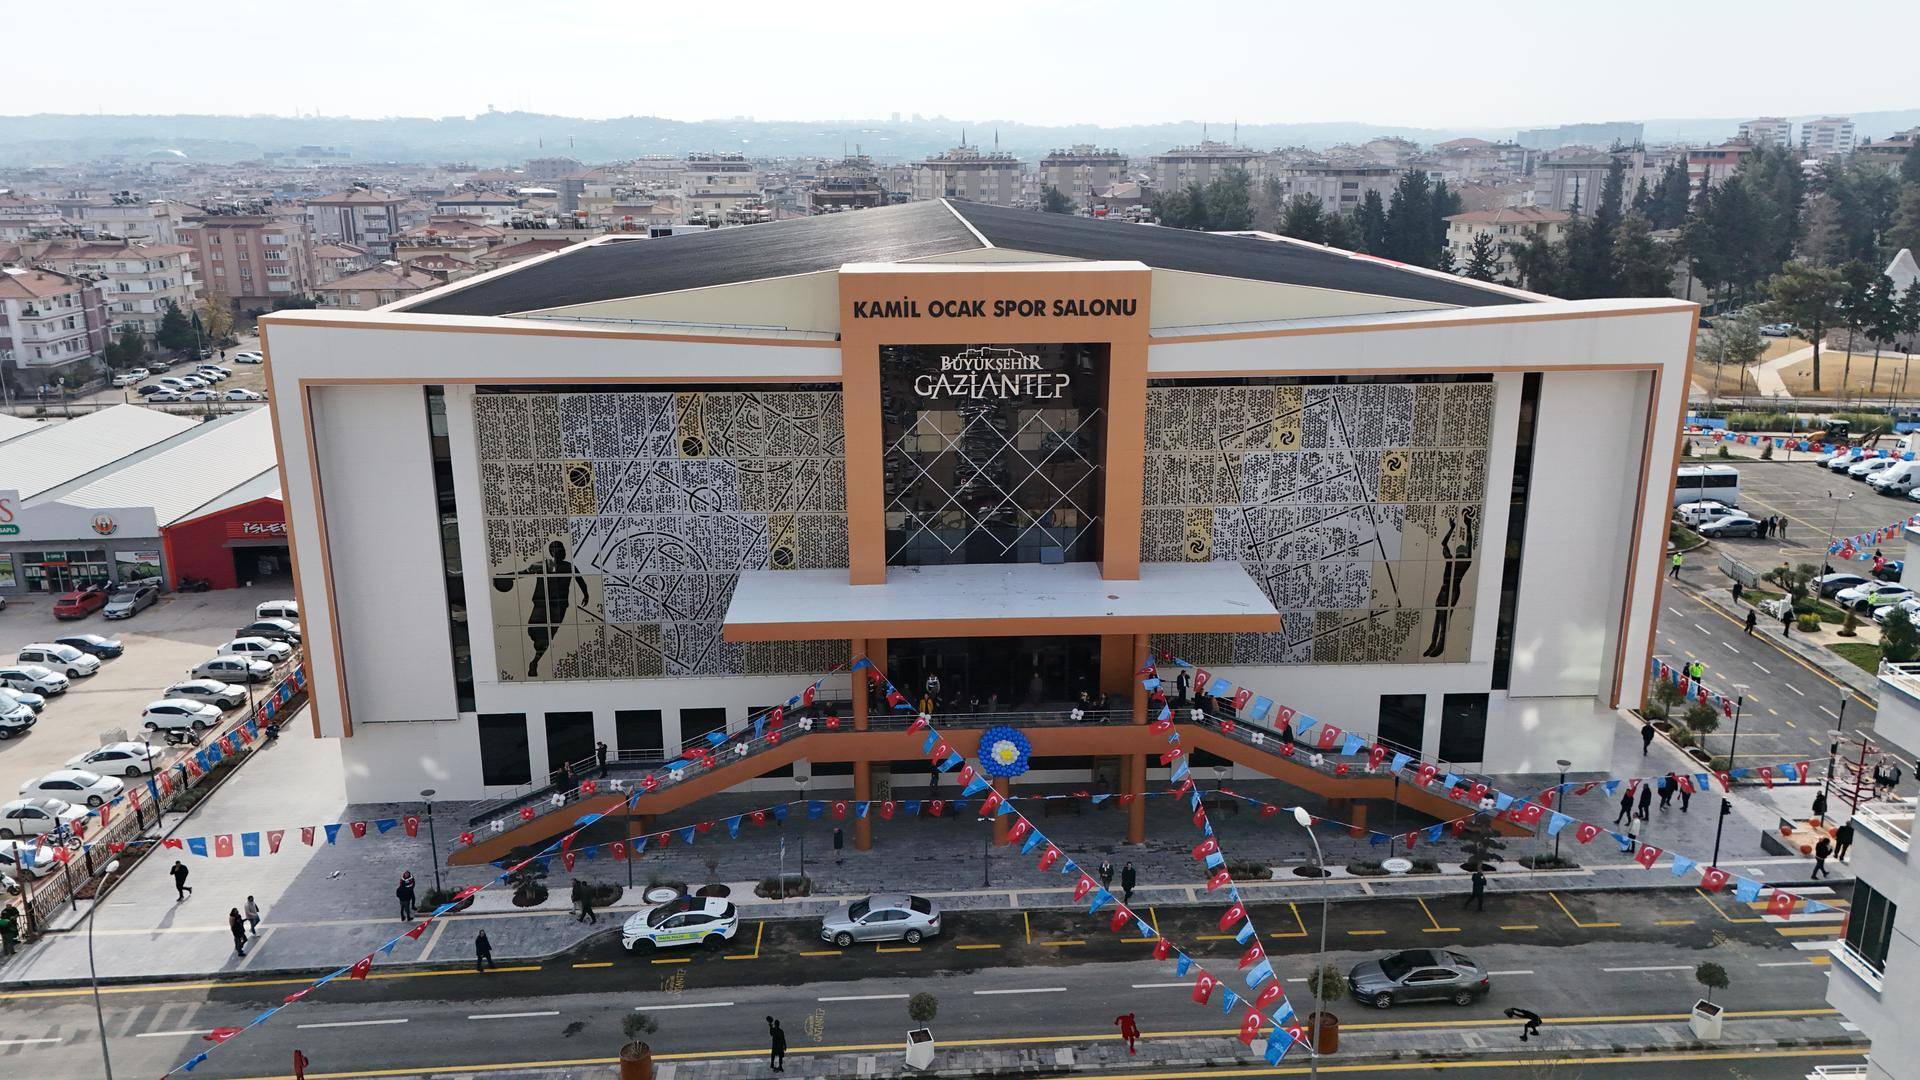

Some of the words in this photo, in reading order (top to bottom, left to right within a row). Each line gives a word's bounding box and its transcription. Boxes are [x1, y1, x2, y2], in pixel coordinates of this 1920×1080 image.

[853, 296, 921, 318] KAMİL
[928, 300, 986, 318] OCAK
[993, 299, 1046, 318] SPOR
[1052, 299, 1137, 317] SALONU
[914, 371, 1070, 399] GAZİANTEP
